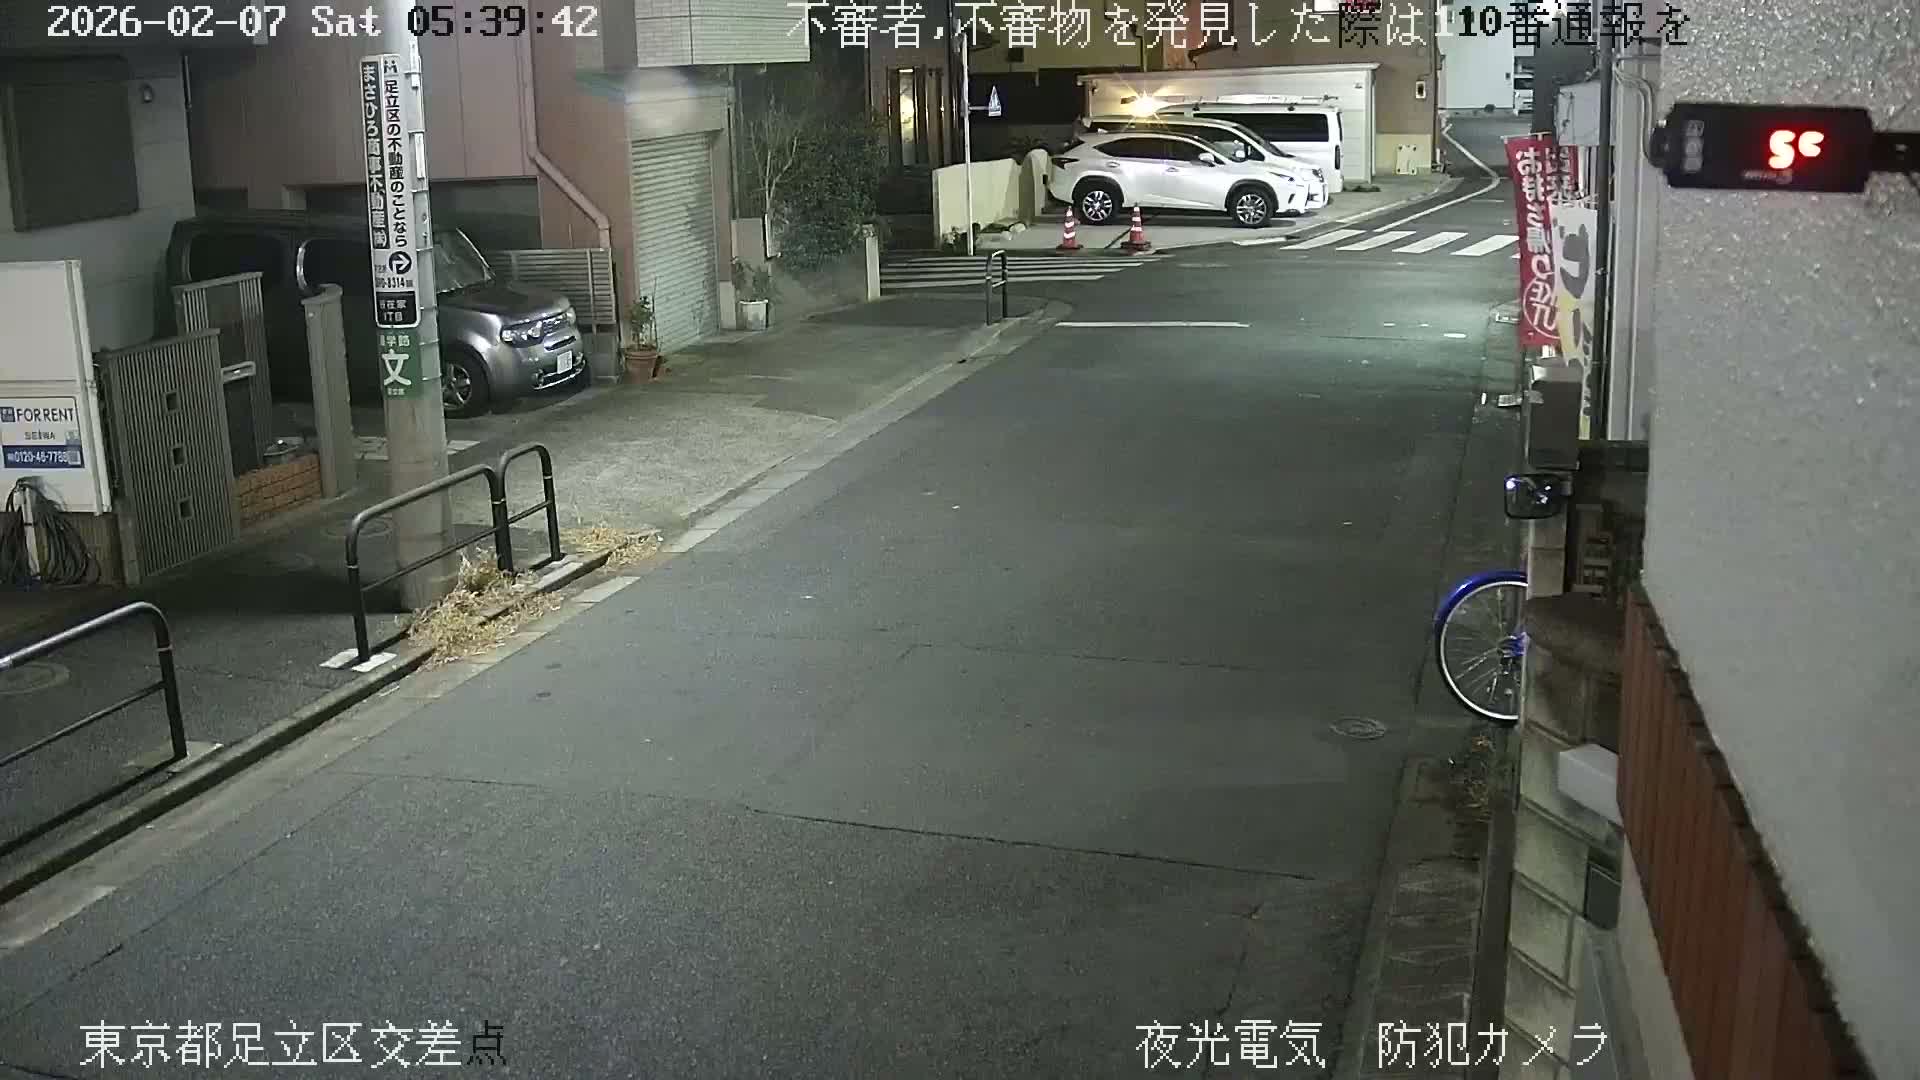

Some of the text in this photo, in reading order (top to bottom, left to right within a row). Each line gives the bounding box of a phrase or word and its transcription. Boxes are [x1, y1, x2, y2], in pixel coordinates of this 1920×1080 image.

[384, 79, 408, 248] 足立区の不動産のことなら
[381, 348, 412, 386] 文
[16, 408, 42, 422] FOR
[43, 407, 74, 422] RENT
